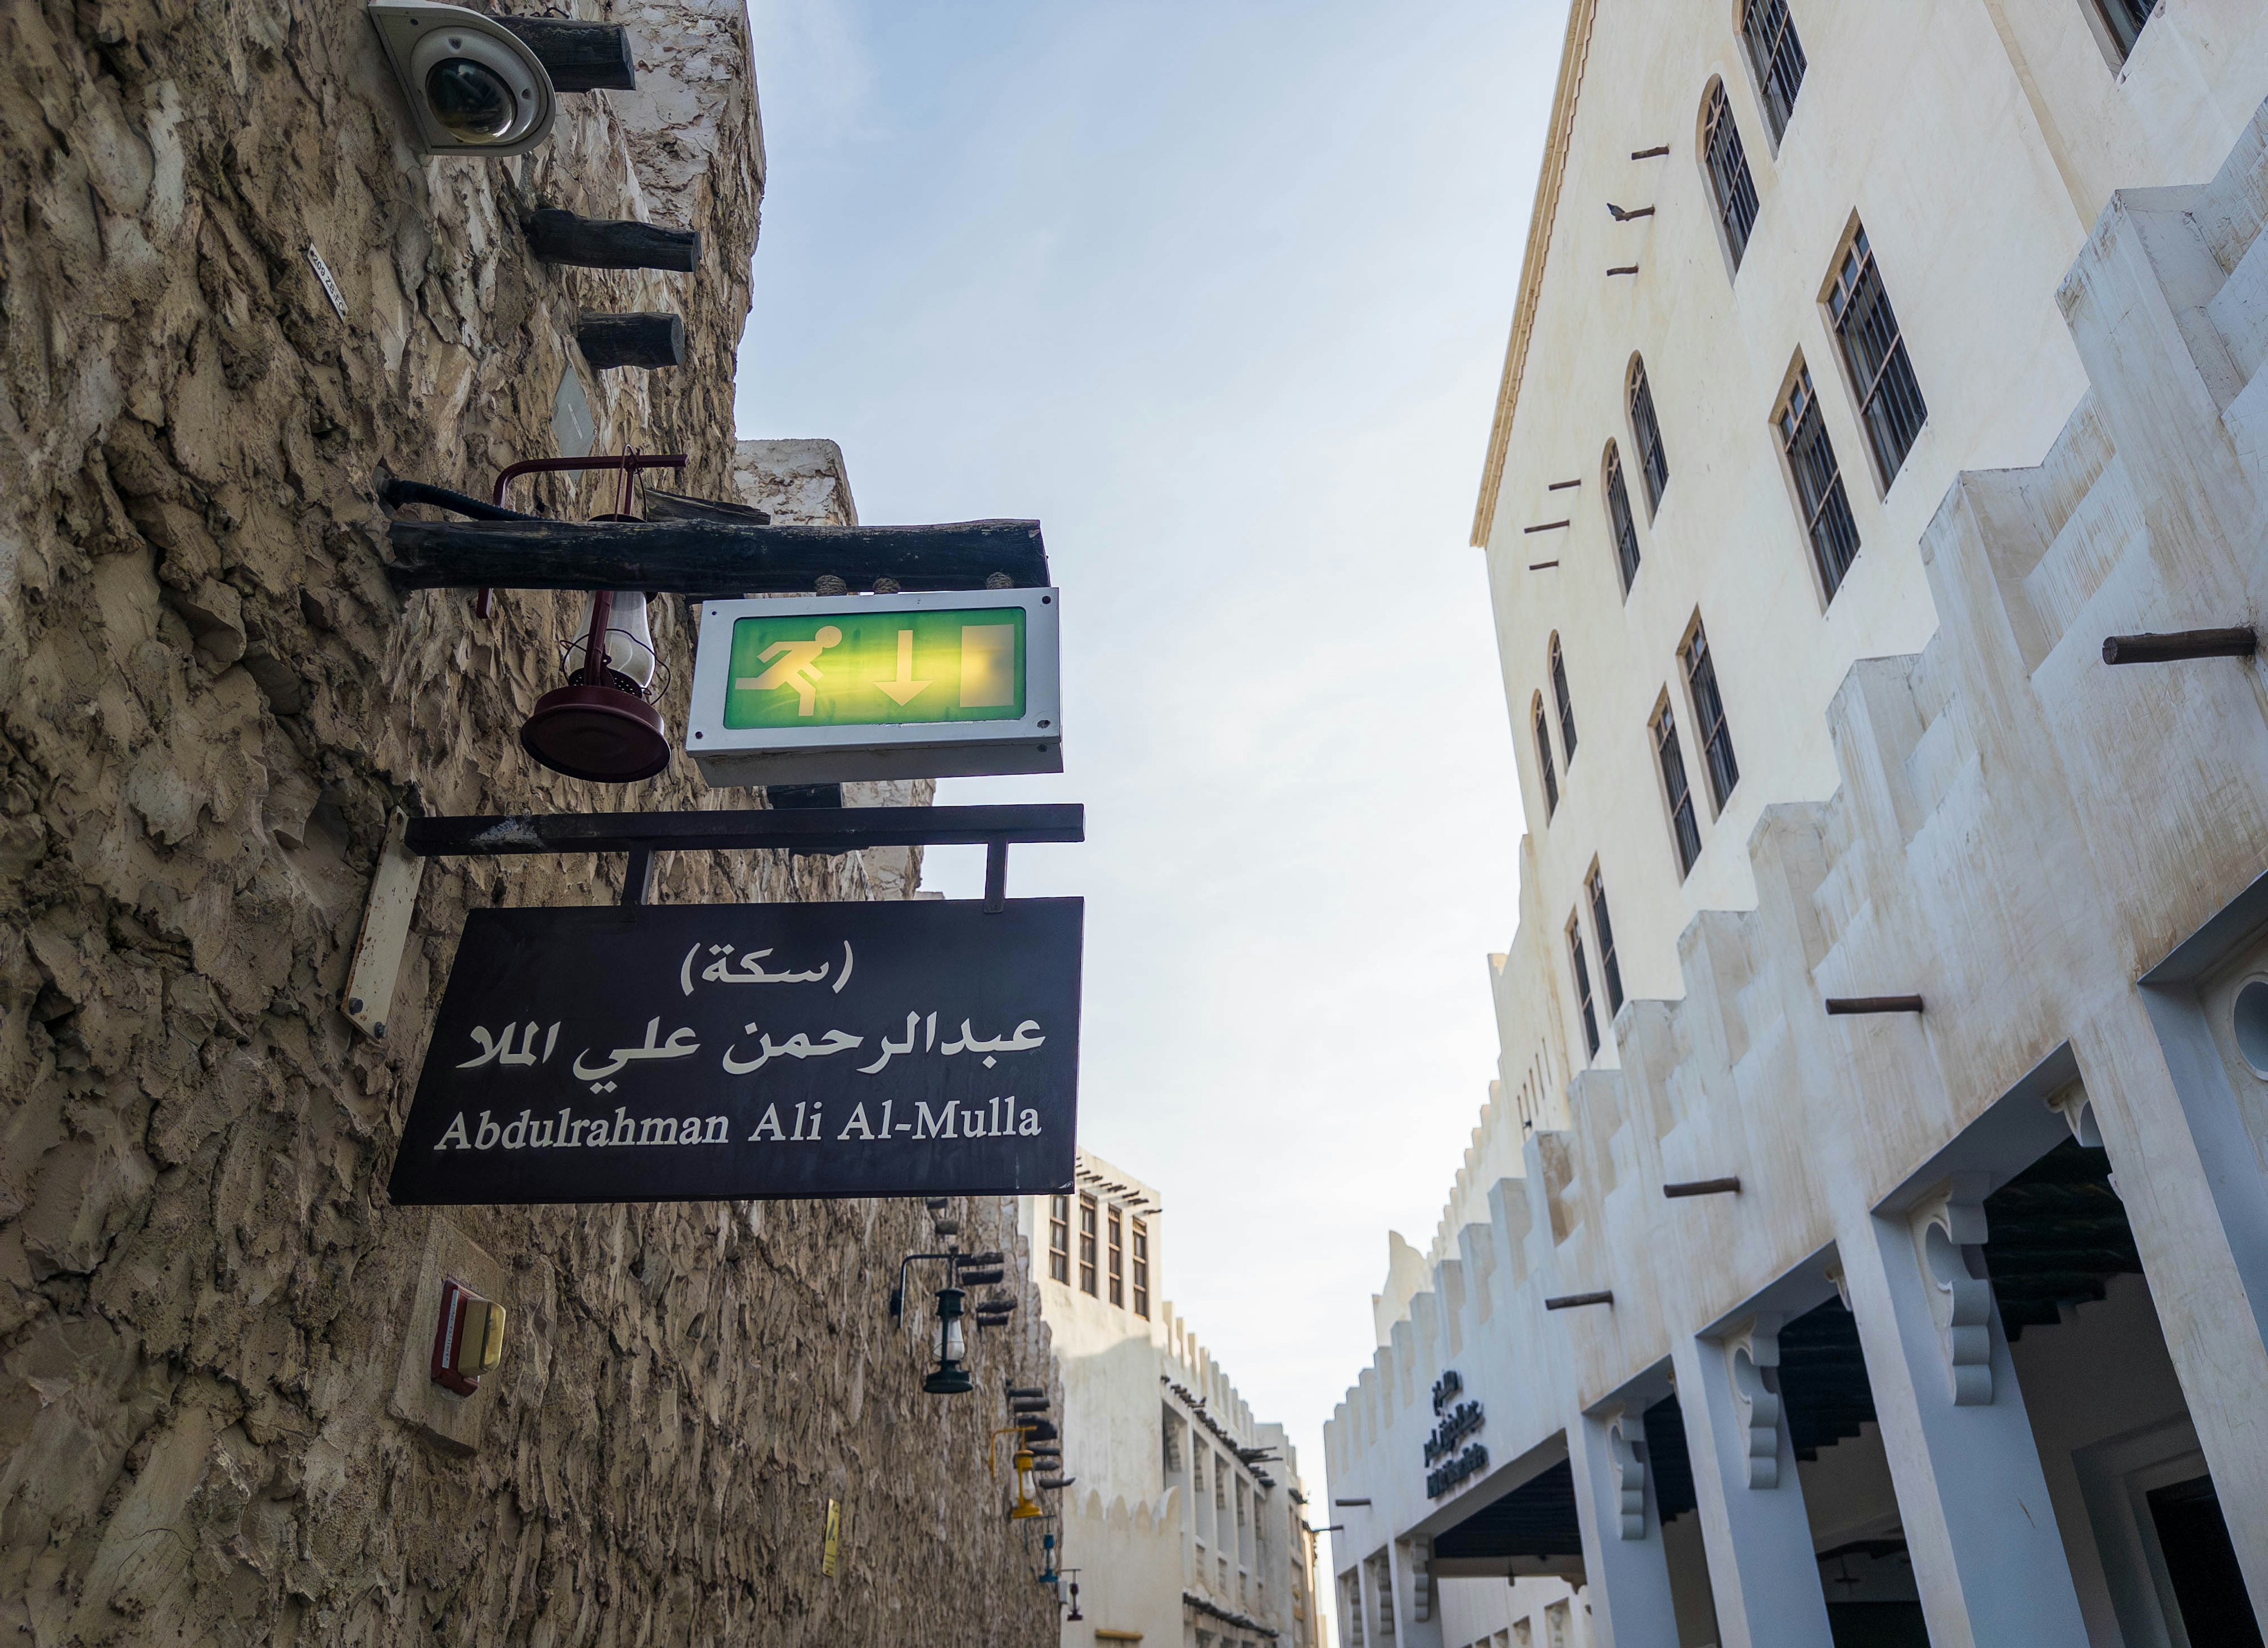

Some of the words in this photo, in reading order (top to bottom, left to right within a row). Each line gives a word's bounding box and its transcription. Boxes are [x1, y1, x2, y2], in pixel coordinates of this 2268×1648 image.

[312, 255, 325, 276] 209
[680, 940, 854, 996] (سكة)
[455, 1021, 561, 1069] الملا
[573, 1015, 700, 1094] علي
[434, 1106, 729, 1150] Abdulrahman
[748, 1100, 823, 1142] Ali
[837, 1096, 1042, 1141] Al-Mulla
